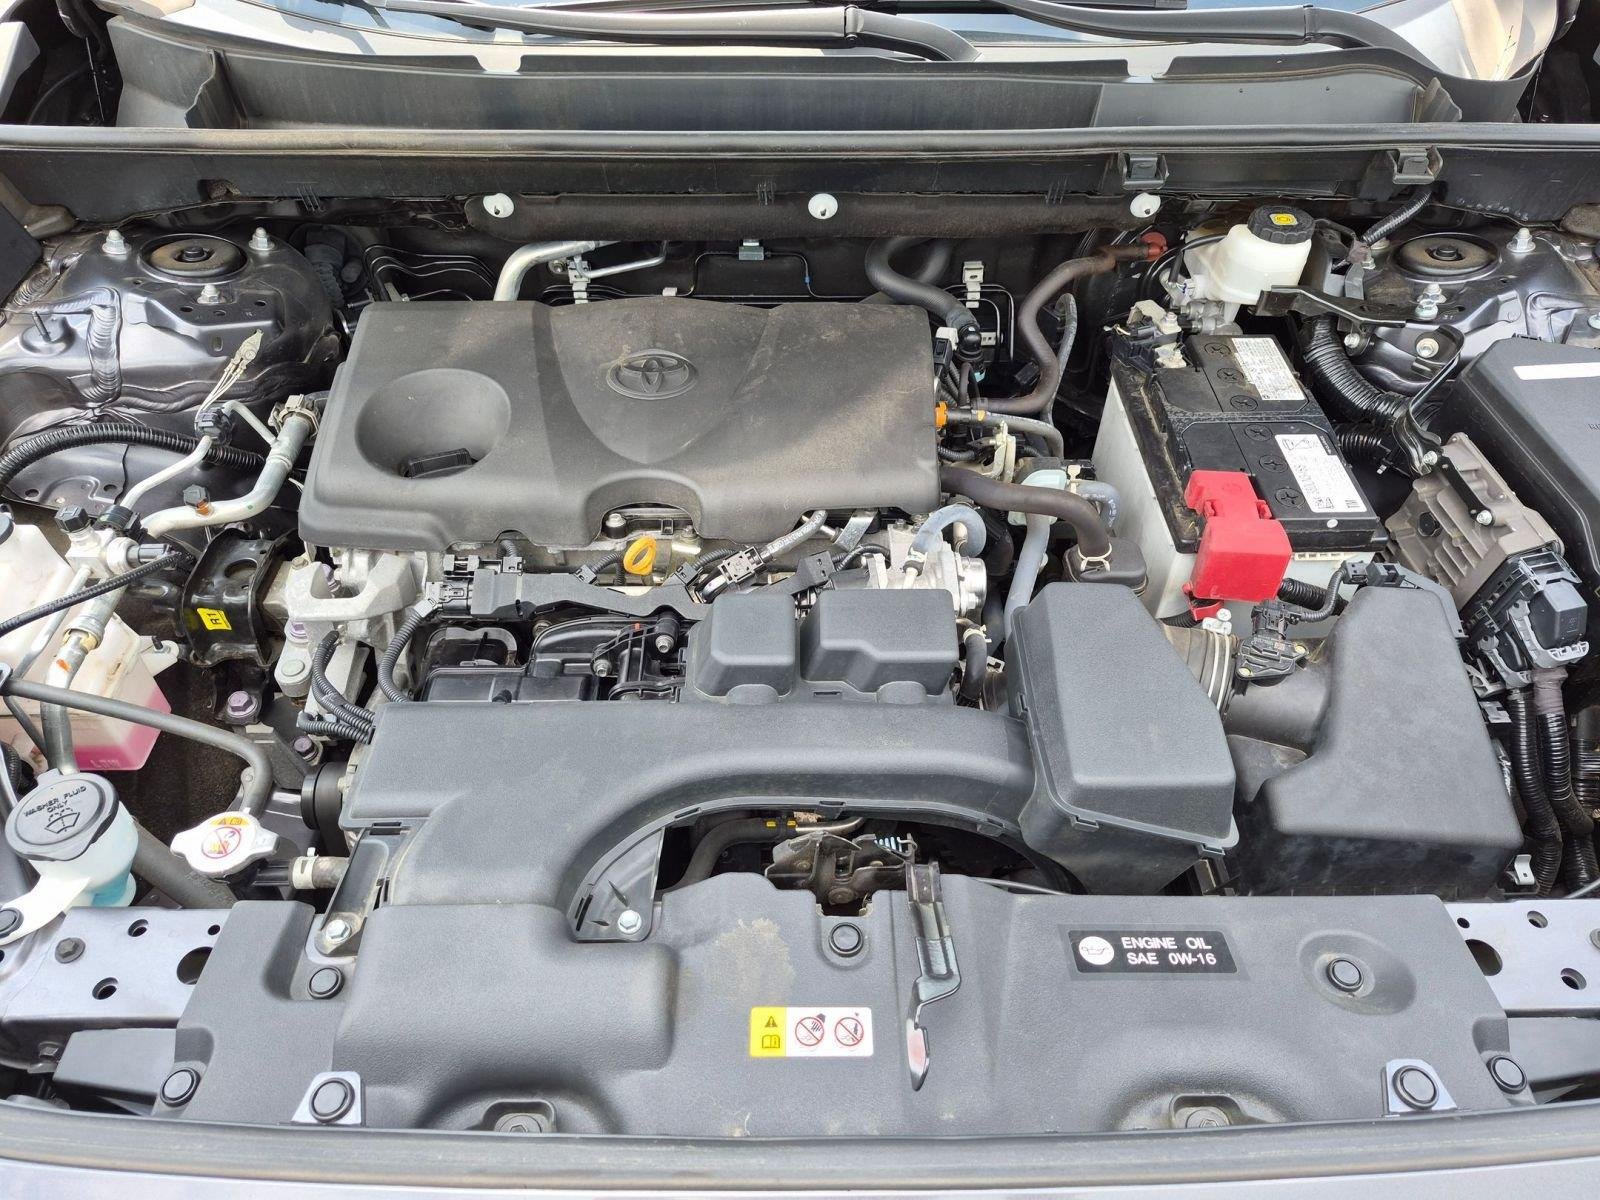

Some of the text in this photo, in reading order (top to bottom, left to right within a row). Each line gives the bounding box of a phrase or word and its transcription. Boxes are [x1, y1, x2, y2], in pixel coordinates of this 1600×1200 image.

[24, 785, 87, 817] WASHER FLUID
[47, 800, 68, 813] ONLY
[1121, 936, 1212, 950] ENGINE OIL
[1127, 952, 1217, 966] SAE 0W-16
